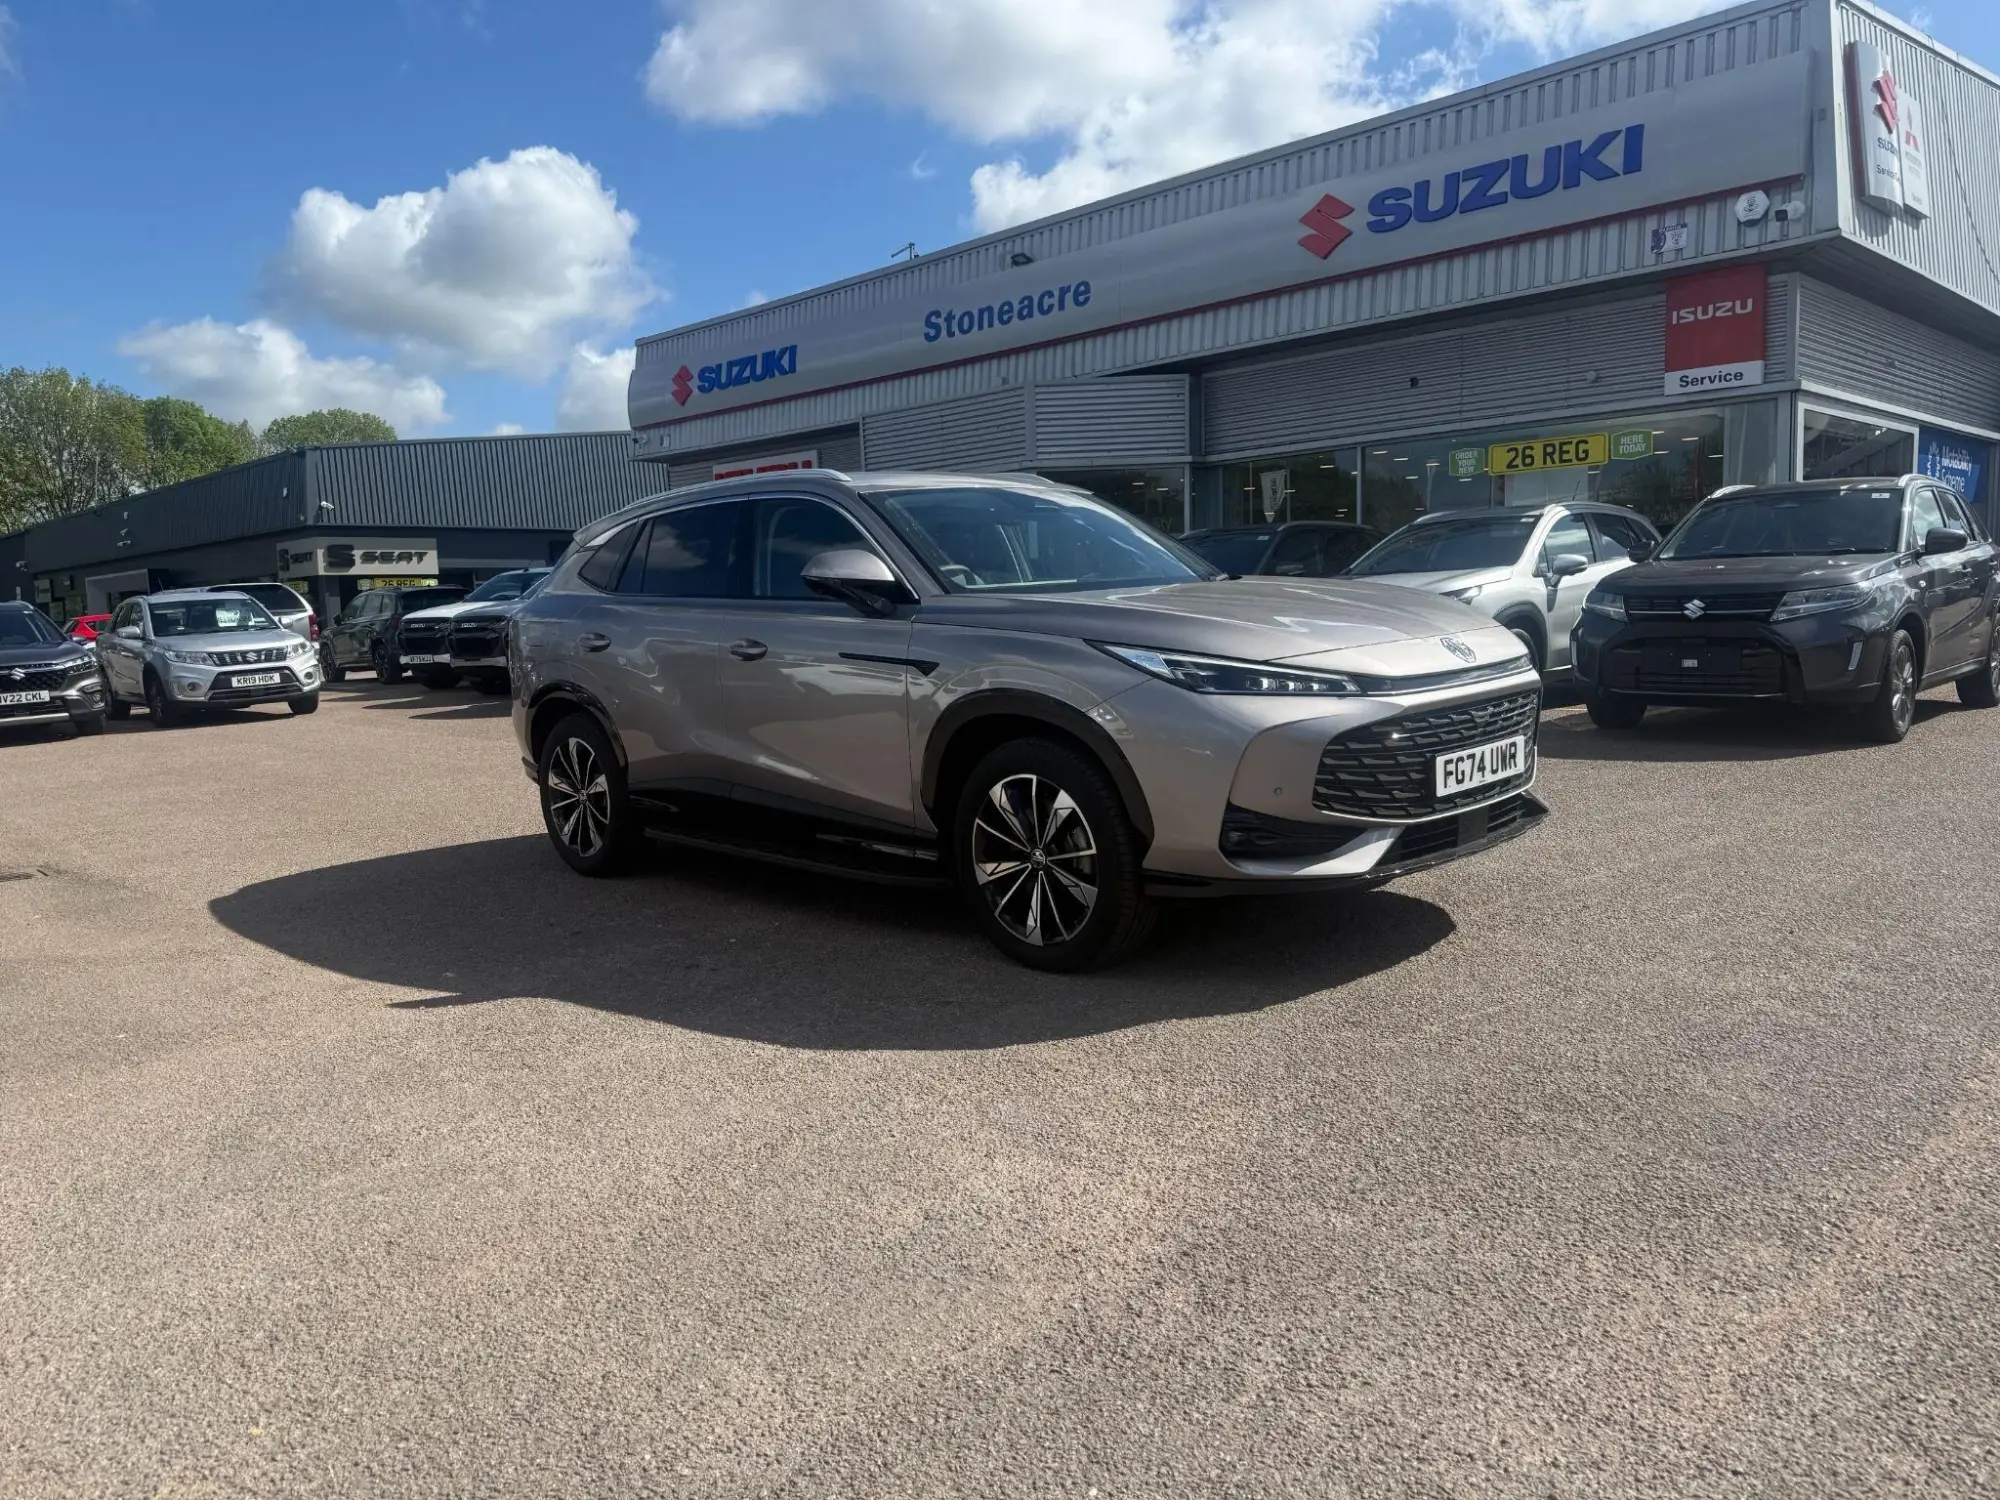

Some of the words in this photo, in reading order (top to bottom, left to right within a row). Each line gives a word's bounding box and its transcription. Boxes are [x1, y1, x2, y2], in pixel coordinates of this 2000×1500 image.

[1366, 123, 1645, 233] SUZUKI
[924, 280, 1091, 342] Stoneacre
[1672, 298, 1753, 324] ISUZU
[697, 344, 797, 393] SUZUKI
[1679, 370, 1744, 388] Service
[1621, 434, 1644, 444] HERE
[1455, 451, 1478, 459] ORDER
[1506, 445, 1535, 470] 26
[1542, 439, 1589, 466] REG
[1619, 443, 1646, 454] TODAY
[1458, 459, 1476, 467] YOUR
[1459, 466, 1475, 474] NEW
[359, 551, 429, 565] SEAT
[236, 677, 257, 685] KR19
[257, 674, 275, 683] HDK
[25, 692, 46, 701] CKL
[1443, 750, 1486, 788] FG74
[1490, 741, 1518, 775] UWR
